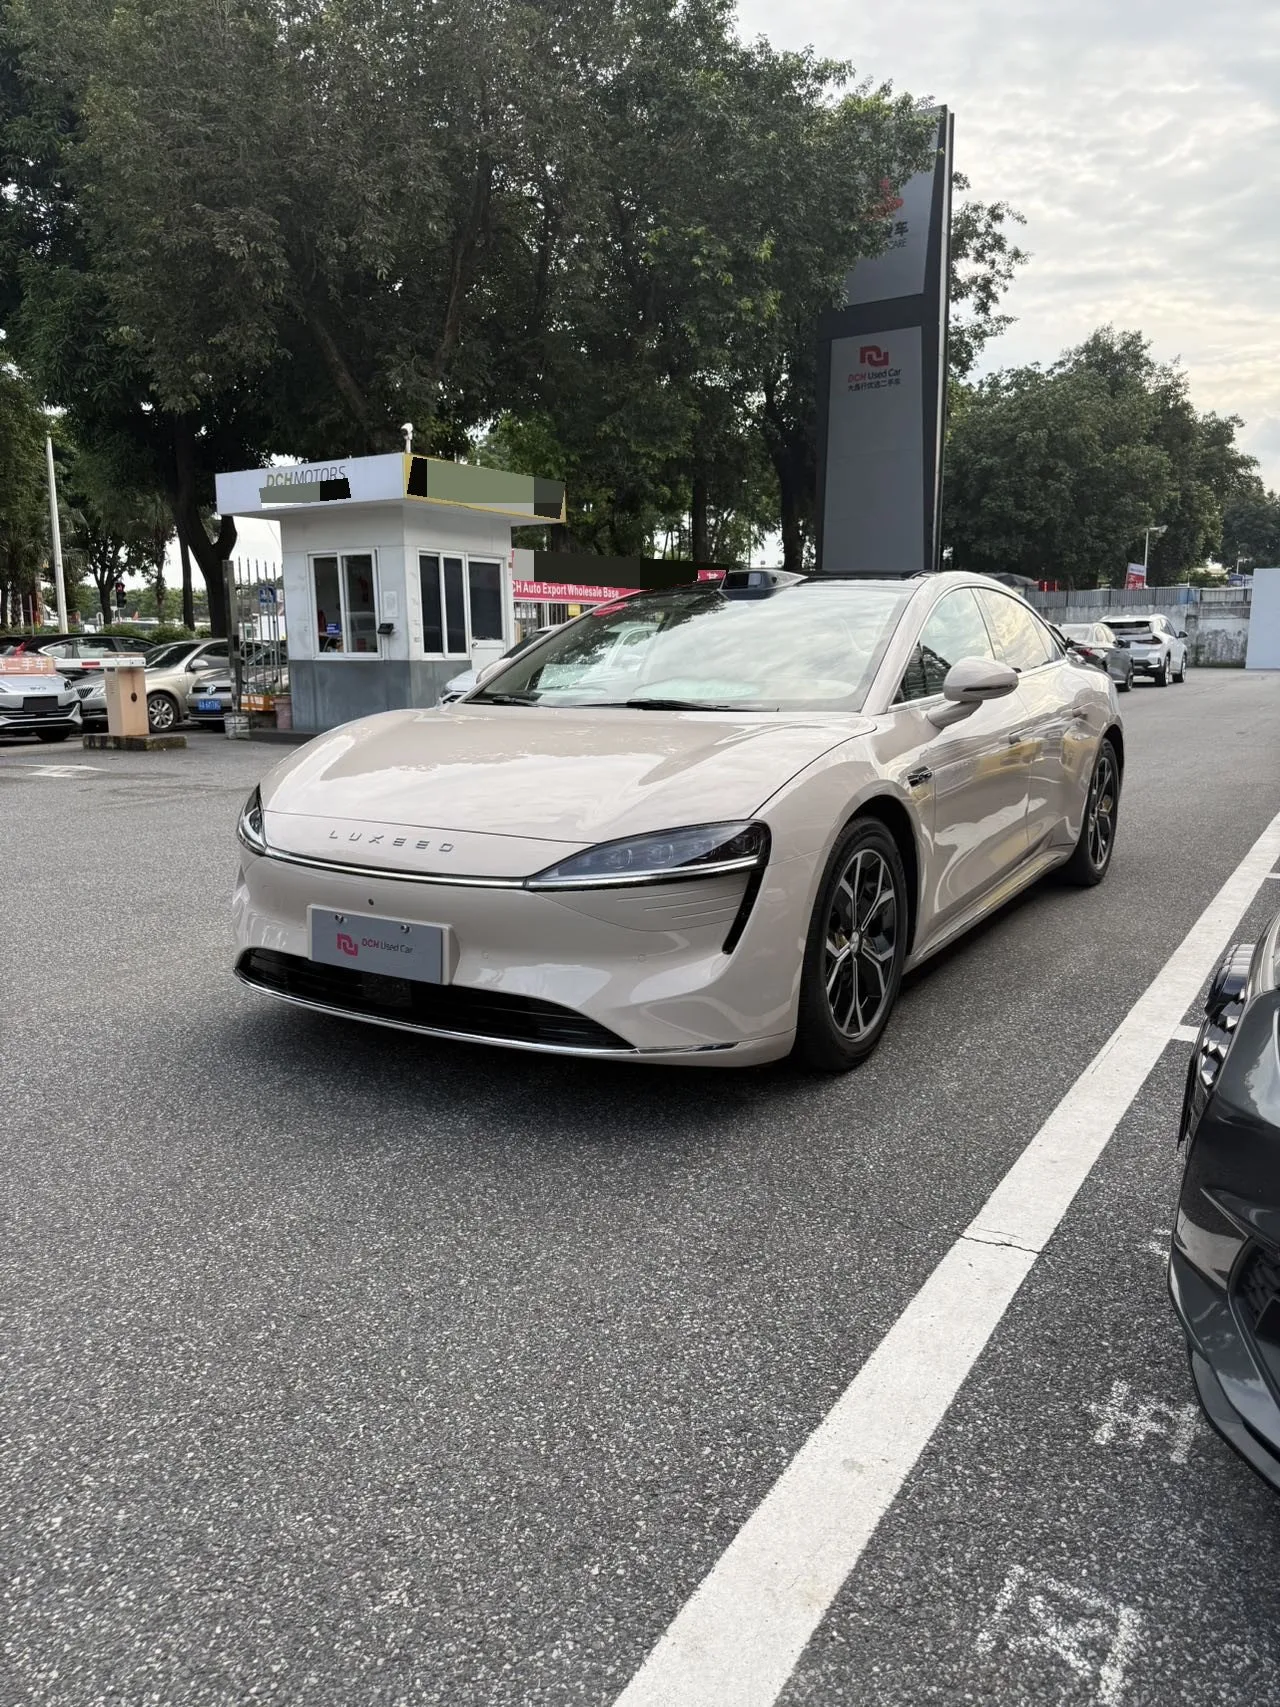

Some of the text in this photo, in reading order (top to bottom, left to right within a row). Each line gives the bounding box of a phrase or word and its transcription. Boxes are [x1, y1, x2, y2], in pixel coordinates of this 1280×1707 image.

[848, 368, 902, 383] DCH Used Car
[523, 582, 542, 594] Auto
[543, 583, 567, 597] Export
[567, 584, 602, 598] Wholesale
[603, 587, 619, 599] Base
[329, 830, 454, 852] LUXEED
[361, 938, 414, 954] DCH Used Car
